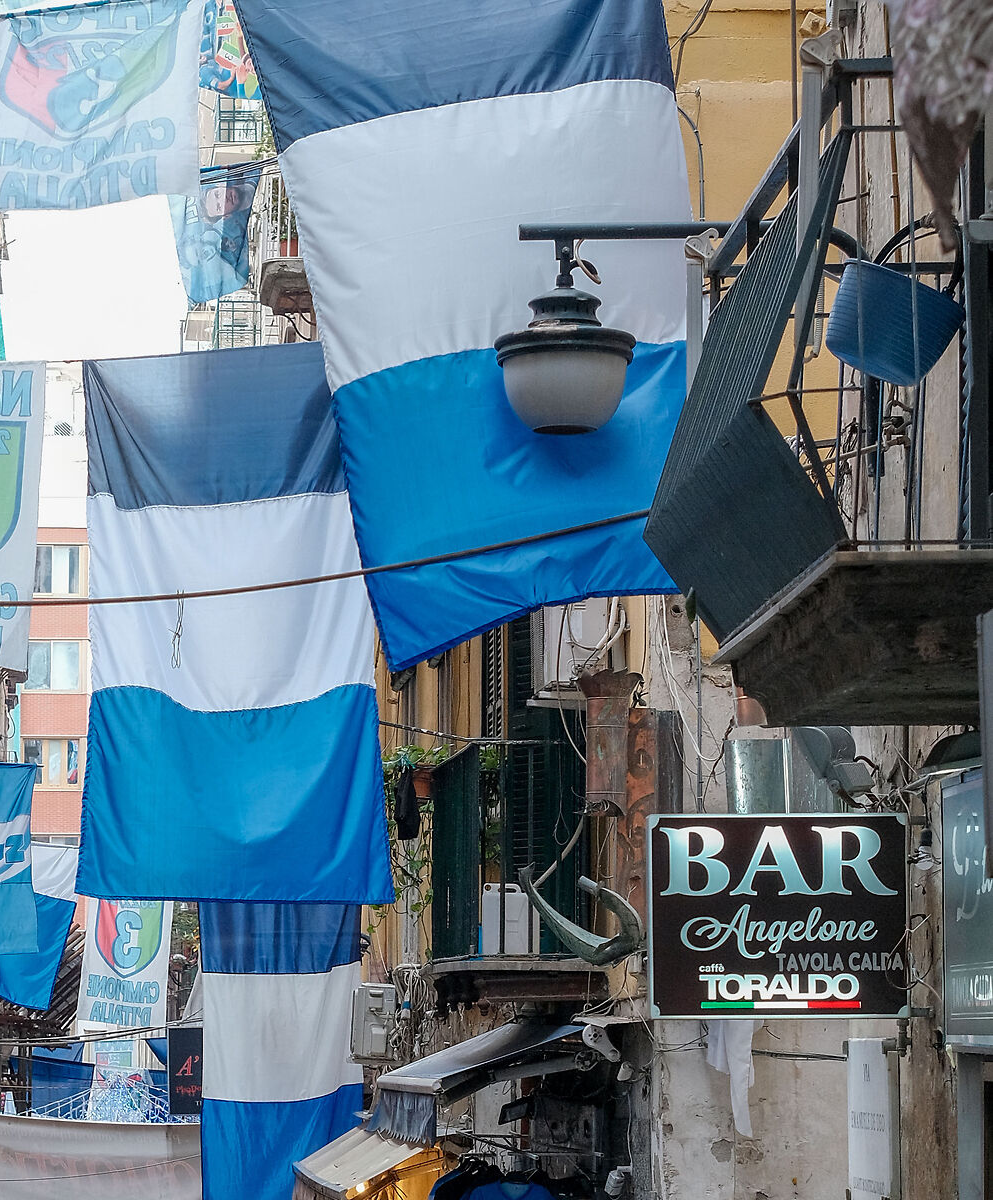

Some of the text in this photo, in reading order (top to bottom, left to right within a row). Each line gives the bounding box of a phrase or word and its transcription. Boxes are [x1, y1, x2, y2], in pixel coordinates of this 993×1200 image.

[659, 825, 899, 897] BAR
[680, 903, 879, 959] Angelone
[698, 962, 725, 973] caffè
[775, 952, 904, 972] TAVOLA CALDA
[698, 973, 860, 1001] TORALDO
